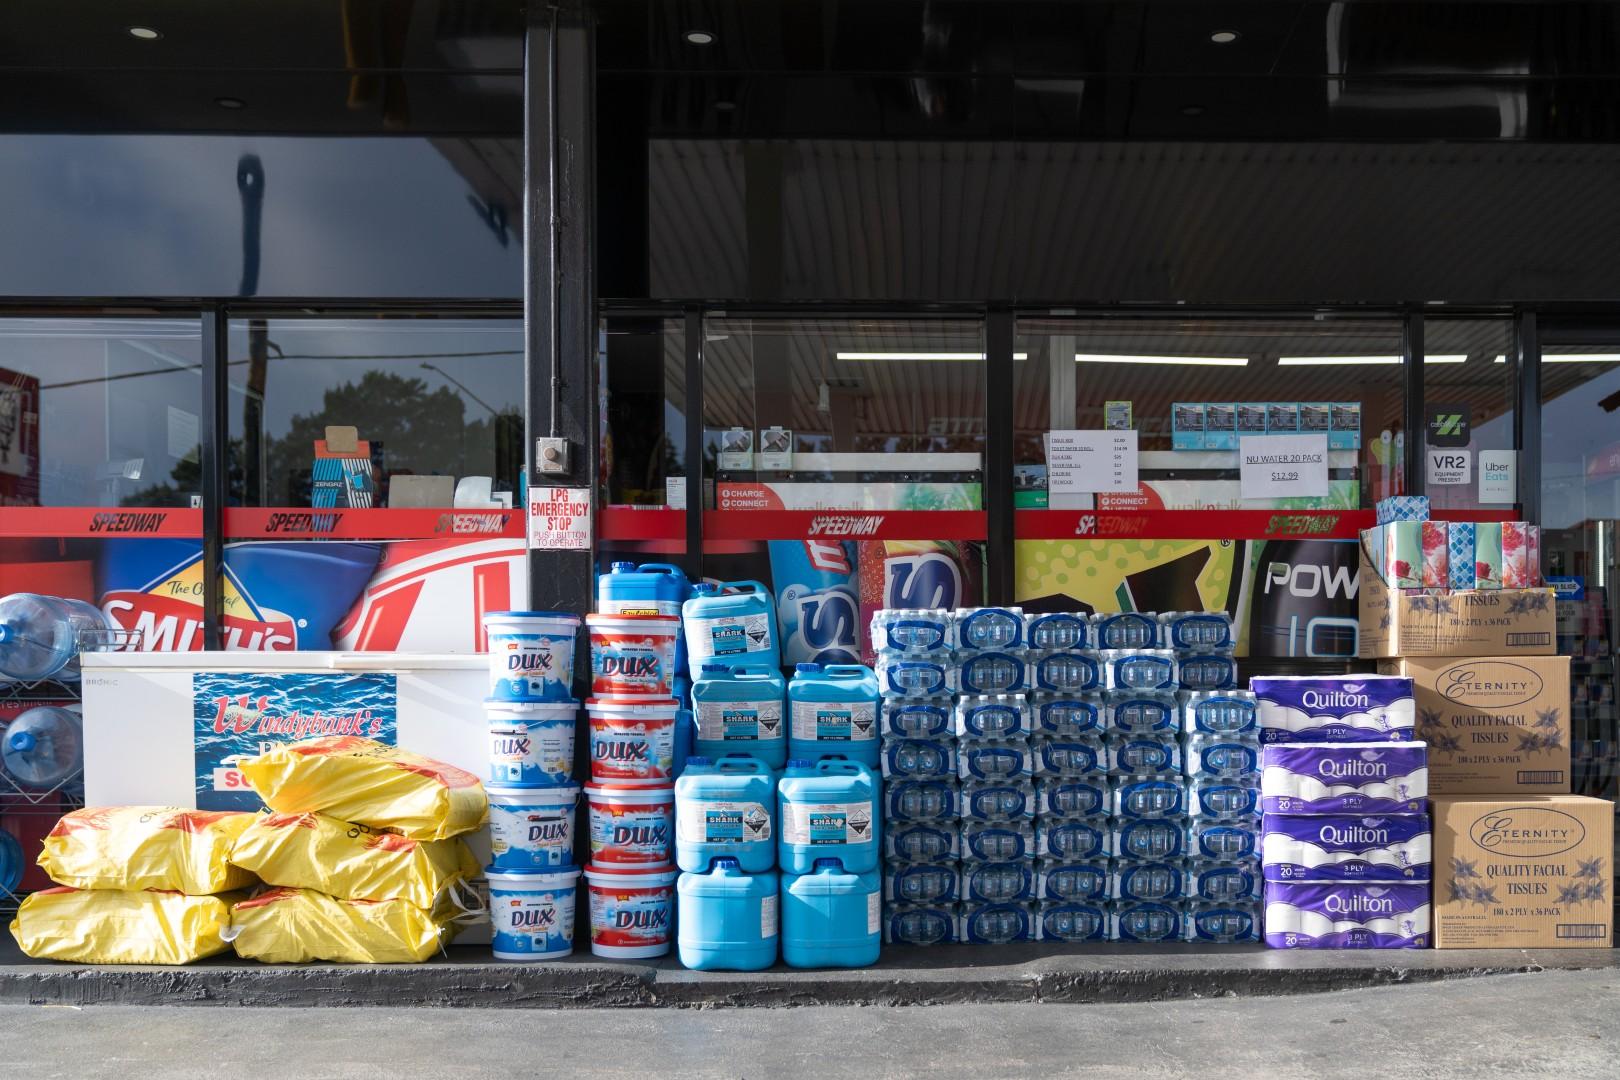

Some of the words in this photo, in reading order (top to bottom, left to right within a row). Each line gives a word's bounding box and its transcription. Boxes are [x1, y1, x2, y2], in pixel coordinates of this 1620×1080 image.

[1246, 455, 1259, 463] NU
[1261, 455, 1288, 463] WATER
[1290, 454, 1301, 463] 20
[1303, 454, 1322, 463] PACK
[1433, 456, 1466, 469] VR2
[1485, 462, 1509, 471] Uber
[1271, 472, 1299, 481] $12.99
[1485, 472, 1509, 481] Eats
[550, 488, 569, 502] LPG
[731, 490, 765, 498] CHARGE
[1111, 497, 1148, 505] CONNECT
[531, 503, 589, 517] EMERGENCY
[731, 499, 769, 507] CONNECT
[89, 513, 167, 532] SPEEDWAY
[265, 513, 343, 533] SPEEDWAY
[434, 514, 510, 533] SPEEDWAY
[547, 517, 572, 531] STOP
[807, 515, 885, 536] SPEEDWAY
[1075, 515, 1148, 535] SPEEDWAY
[1265, 515, 1342, 535] SPEEDWAY
[534, 531, 555, 539] PUSH
[556, 531, 587, 539] BUTTON
[538, 539, 548, 547] TO
[550, 539, 583, 547] OPERATE
[167, 580, 191, 595] The
[1464, 594, 1500, 607] TISSUES
[715, 630, 742, 638] SHARK
[509, 653, 552, 671] DUX
[603, 656, 659, 677] DUX
[1446, 670, 1528, 698] ETERNITY
[1302, 691, 1368, 709] Quilton
[213, 696, 382, 739] Windybank's
[1452, 715, 1493, 728] QUALITY
[1495, 715, 1528, 726] FACIAL
[1265, 733, 1276, 741] 20
[1471, 732, 1509, 743] TISSUES
[494, 738, 531, 756] DUX
[597, 741, 649, 762] DUX
[1319, 758, 1387, 778] Quilton
[1279, 801, 1290, 809] 20
[529, 823, 569, 842] DUX
[614, 825, 668, 846] DUX
[1320, 825, 1388, 845] Quilton
[1480, 816, 1568, 847] ETERNITY
[1281, 868, 1292, 876] 20
[1486, 864, 1530, 878] QUALITY
[1534, 864, 1569, 876] FACIAL
[1507, 883, 1547, 894] TISSUES
[1325, 894, 1393, 913] Quilton
[512, 908, 555, 928] DUX
[616, 909, 668, 929] DUX
[1493, 908, 1504, 916] 180
[1515, 908, 1527, 916] PLY
[1535, 908, 1543, 916] 36
[1543, 908, 1561, 916] PACK
[1285, 937, 1297, 945] 20
